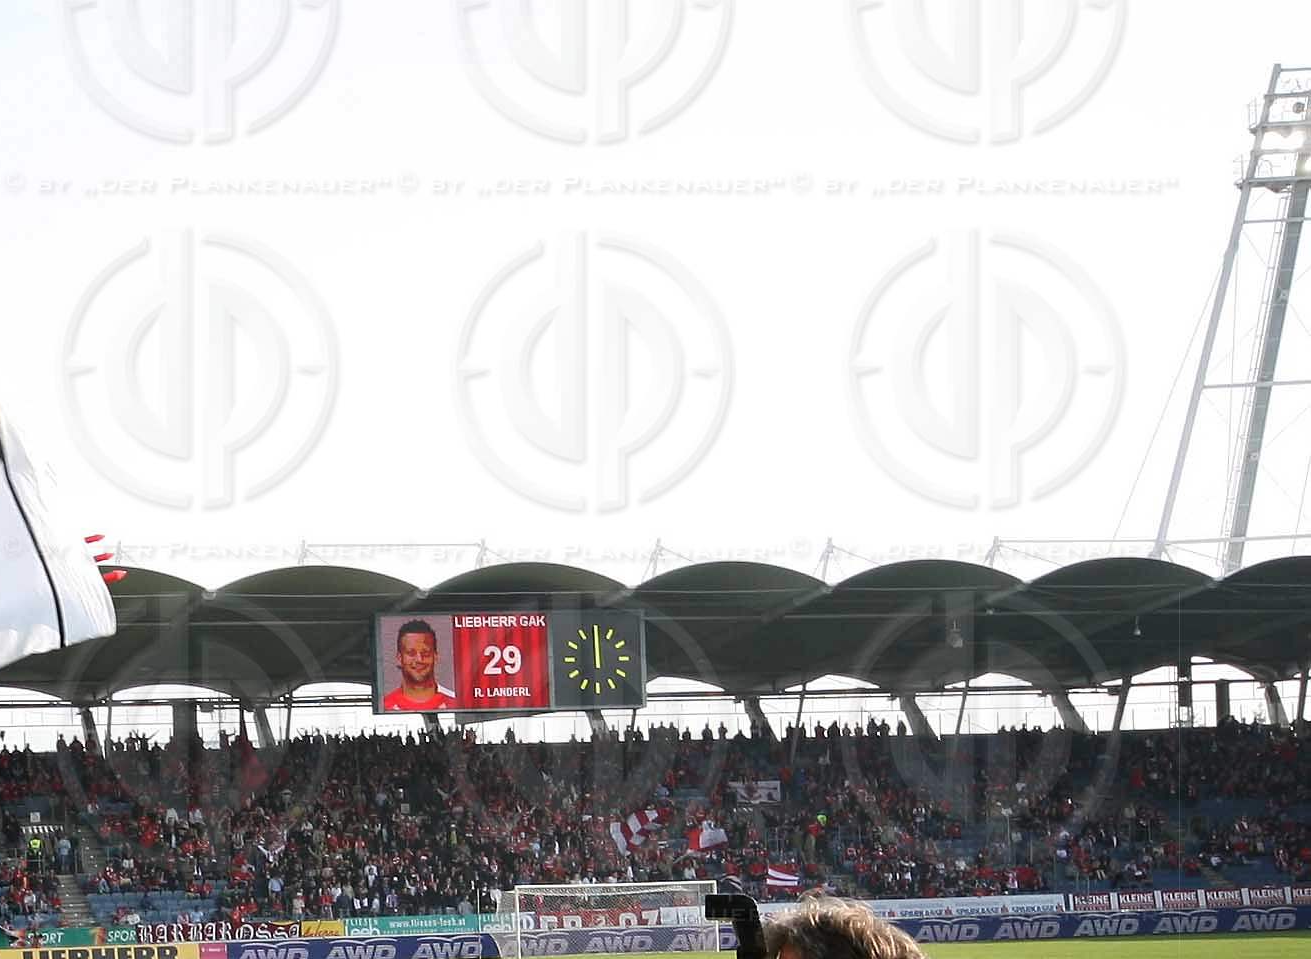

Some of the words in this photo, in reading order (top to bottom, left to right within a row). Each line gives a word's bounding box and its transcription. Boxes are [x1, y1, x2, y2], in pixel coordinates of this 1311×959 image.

[454, 616, 517, 628] LIEBHERR
[519, 615, 546, 627] GAK
[483, 645, 522, 675] 29
[486, 686, 531, 698] LANDERL
[1119, 893, 1154, 904] KLEINE
[1163, 891, 1198, 903] KLEINE
[1207, 890, 1242, 902] KLEINE
[993, 921, 1060, 940] AWD
[1073, 917, 1139, 938] AWD
[1152, 915, 1219, 934] AWD
[1230, 913, 1297, 932] AWD
[913, 924, 979, 941] AWD
